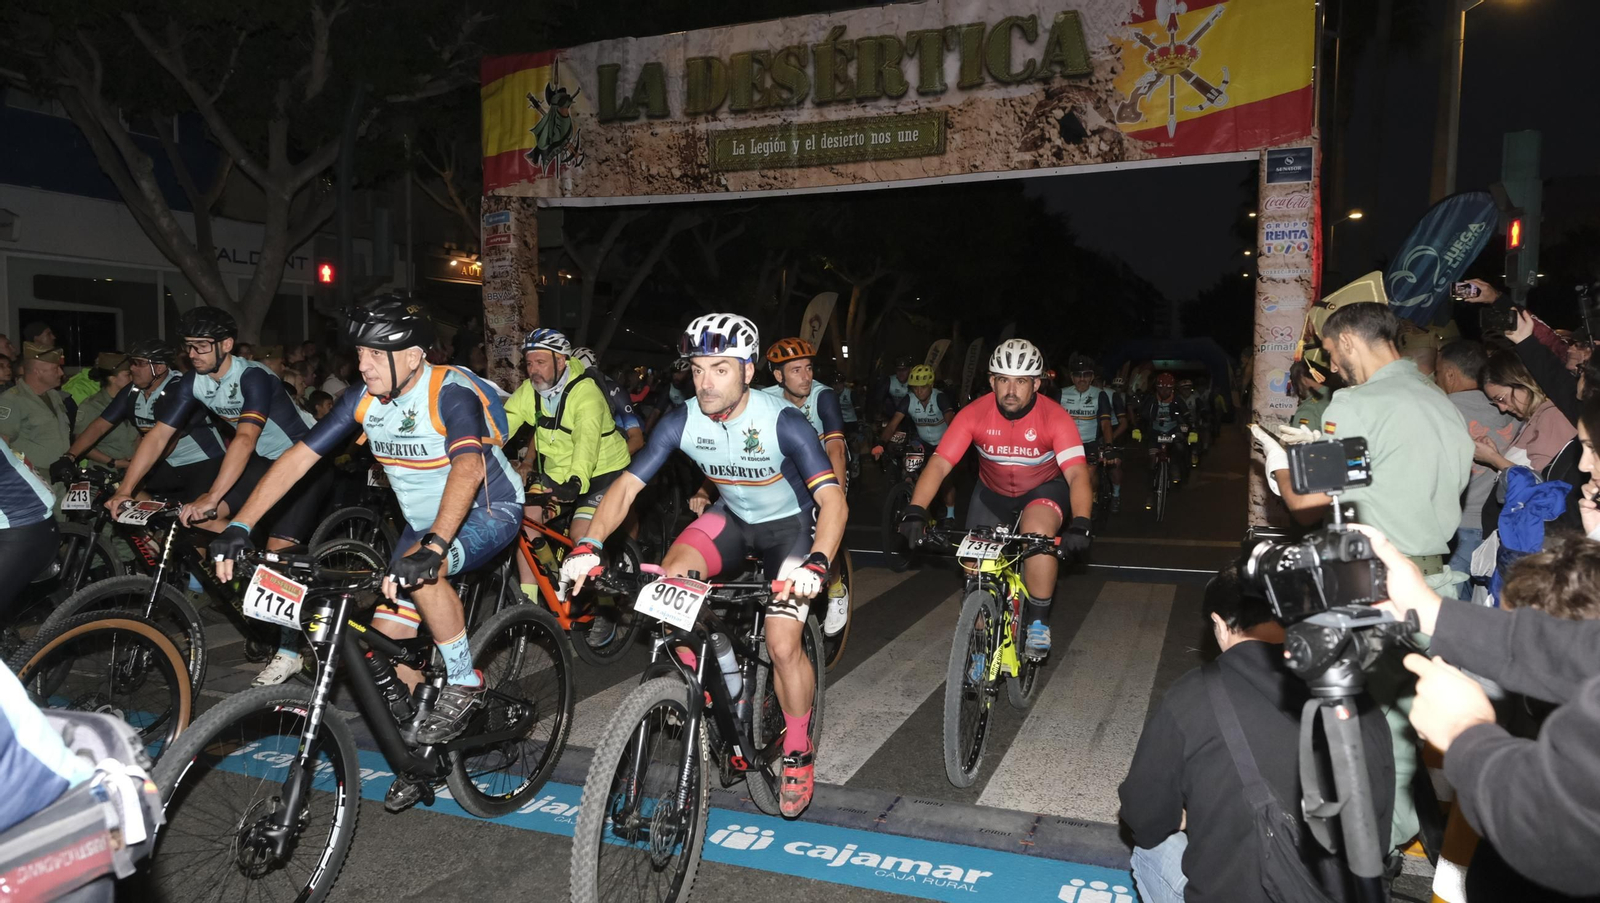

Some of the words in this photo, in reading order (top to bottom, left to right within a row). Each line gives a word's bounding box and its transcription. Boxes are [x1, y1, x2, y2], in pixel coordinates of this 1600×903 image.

[598, 62, 670, 121] LA
[684, 9, 1094, 116] DESÉRTICA
[733, 140, 745, 156] La
[750, 136, 787, 158] Legión
[792, 139, 800, 154] y
[805, 134, 816, 151] el
[821, 130, 865, 149] desierto
[871, 131, 891, 145] nos
[898, 129, 919, 143] une
[1265, 229, 1309, 241] RENTA
[1443, 222, 1482, 266] JUEGA
[461, 264, 482, 277] AUT
[1260, 342, 1297, 353] primafl
[374, 440, 429, 457] DESÉRTICA
[983, 444, 995, 454] LA
[997, 445, 1040, 456] RELENGA
[700, 463, 707, 473] A
[709, 463, 776, 479] DESÉRTICA
[66, 490, 88, 502] 7213
[966, 540, 999, 551] 7314
[254, 586, 295, 621] 7174
[652, 583, 700, 614] 9067
[698, 719, 708, 762] ARZO
[783, 839, 994, 884] cajamar
[874, 869, 917, 883] CAJA
[922, 876, 979, 893] RURAL
